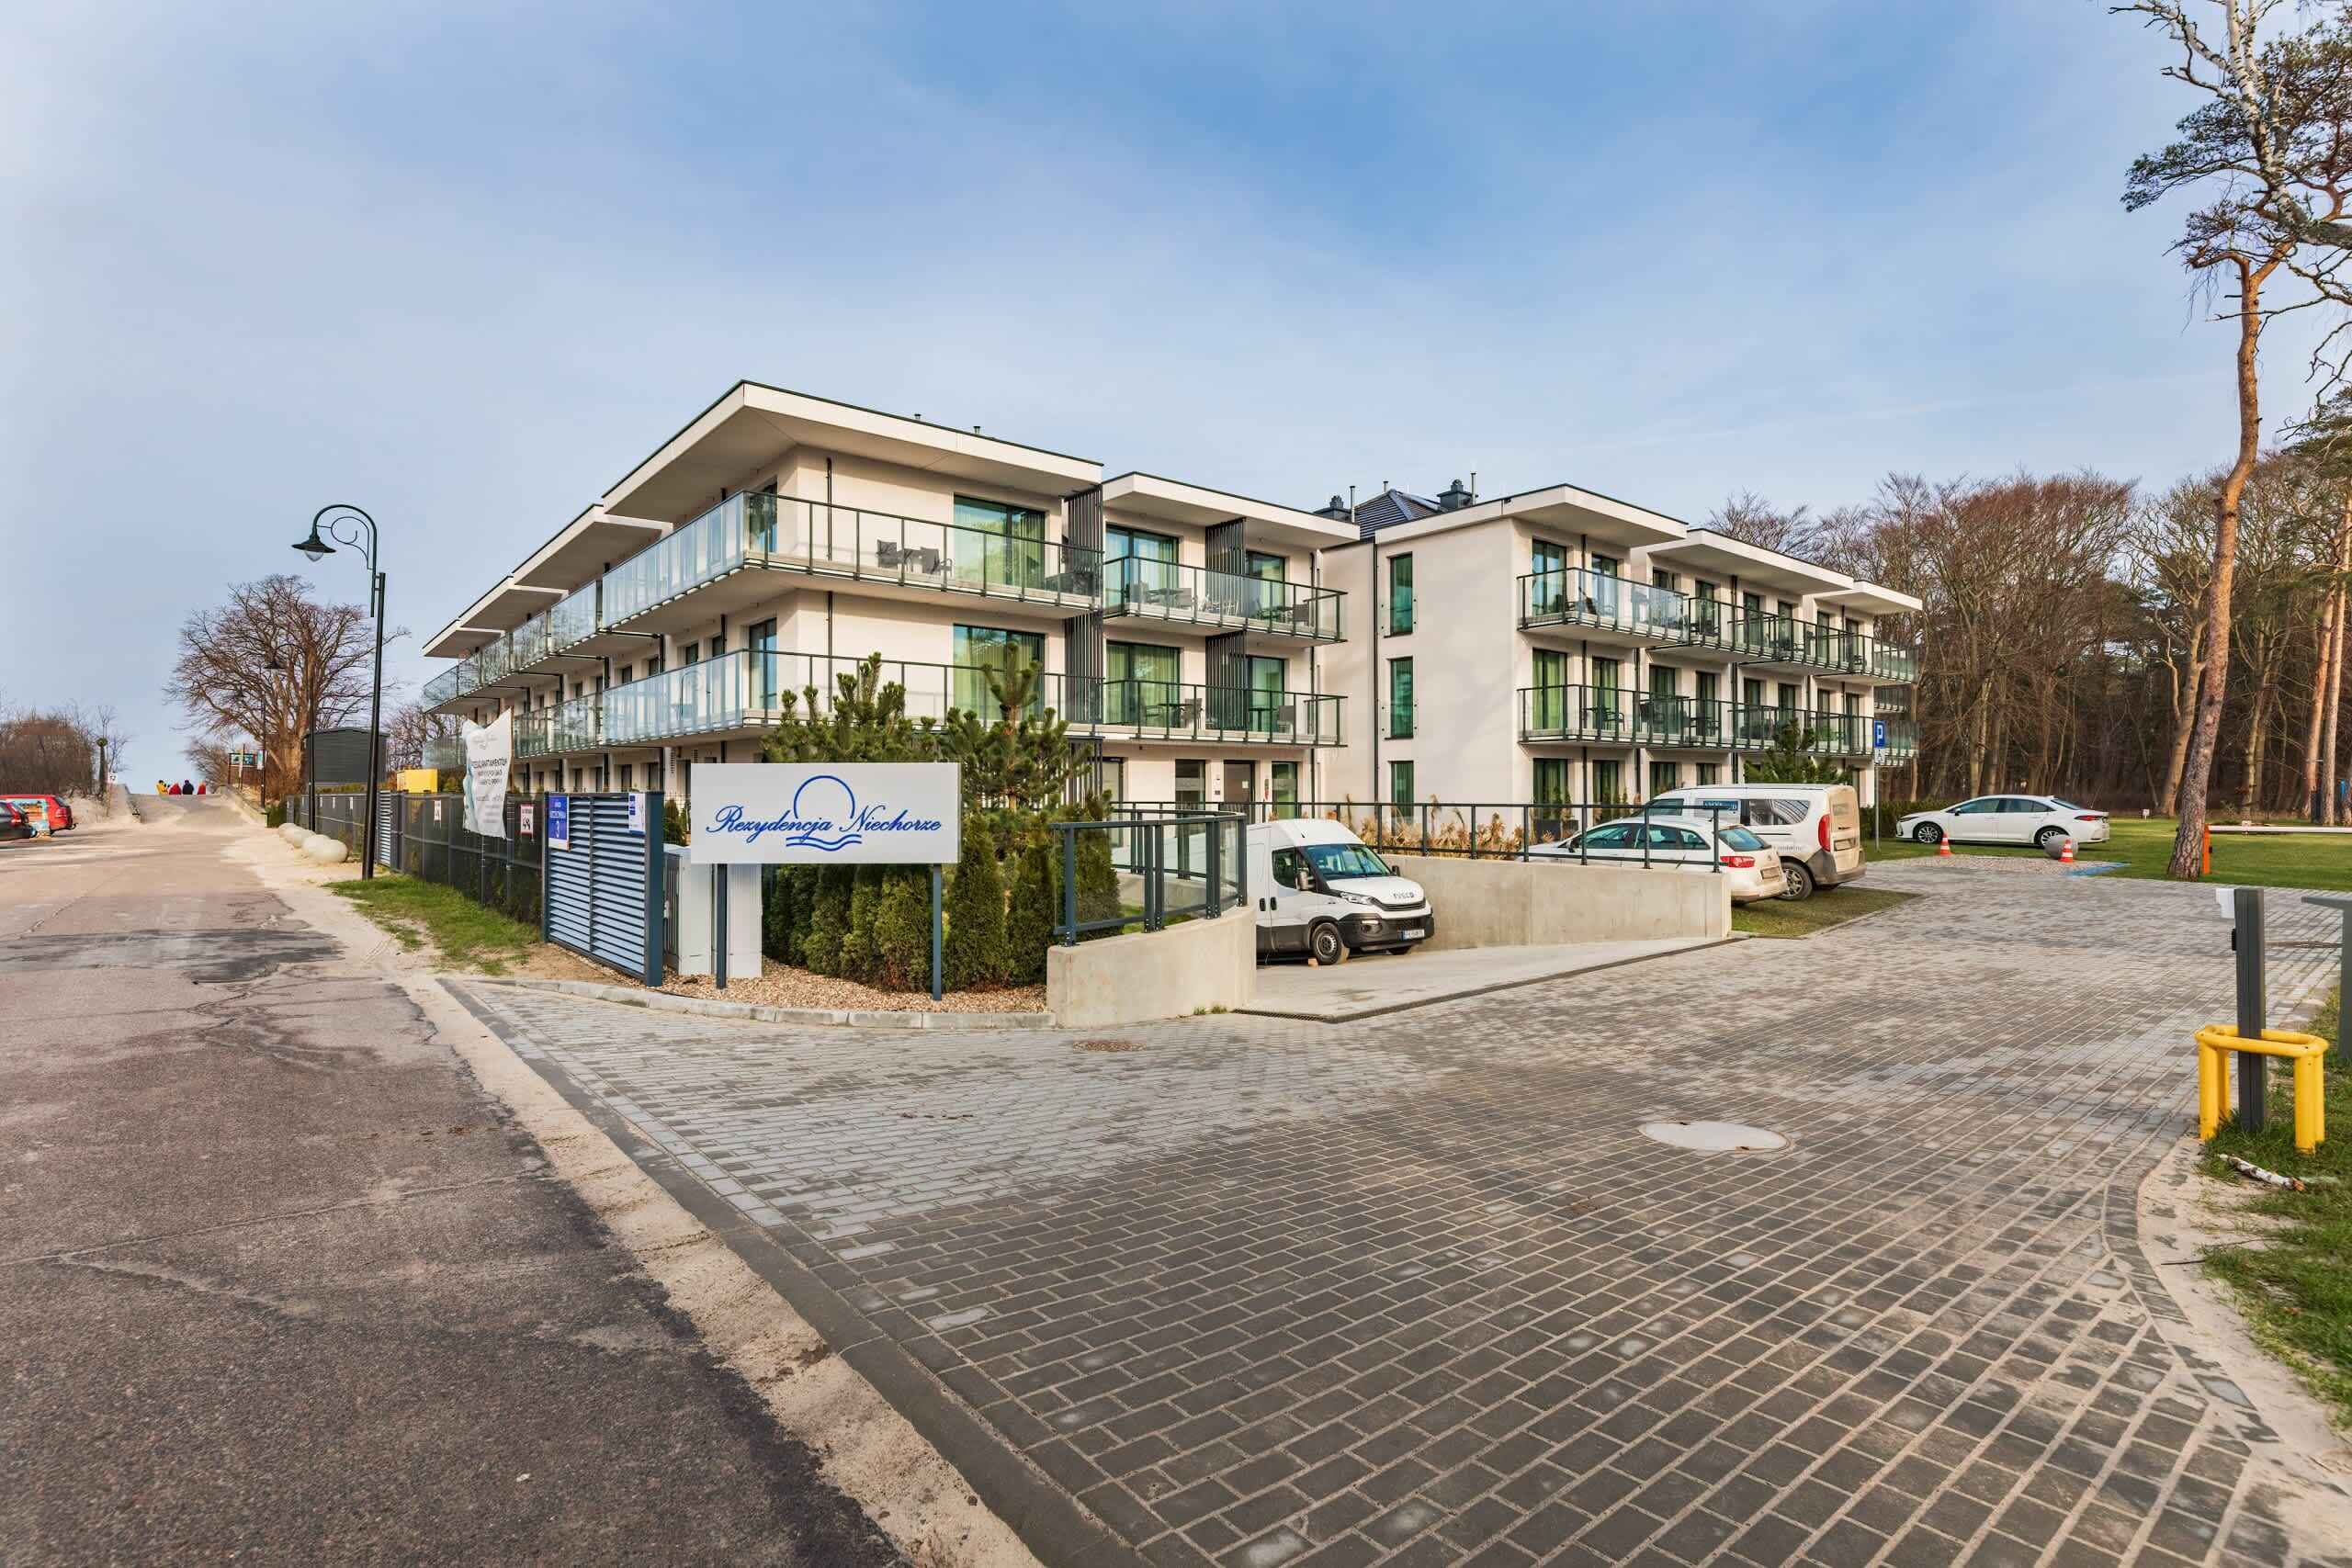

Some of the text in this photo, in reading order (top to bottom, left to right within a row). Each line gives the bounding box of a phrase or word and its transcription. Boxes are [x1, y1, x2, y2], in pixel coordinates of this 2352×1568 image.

[1876, 724, 1883, 745] P
[706, 805, 942, 843] Rezydencja Niechorze
